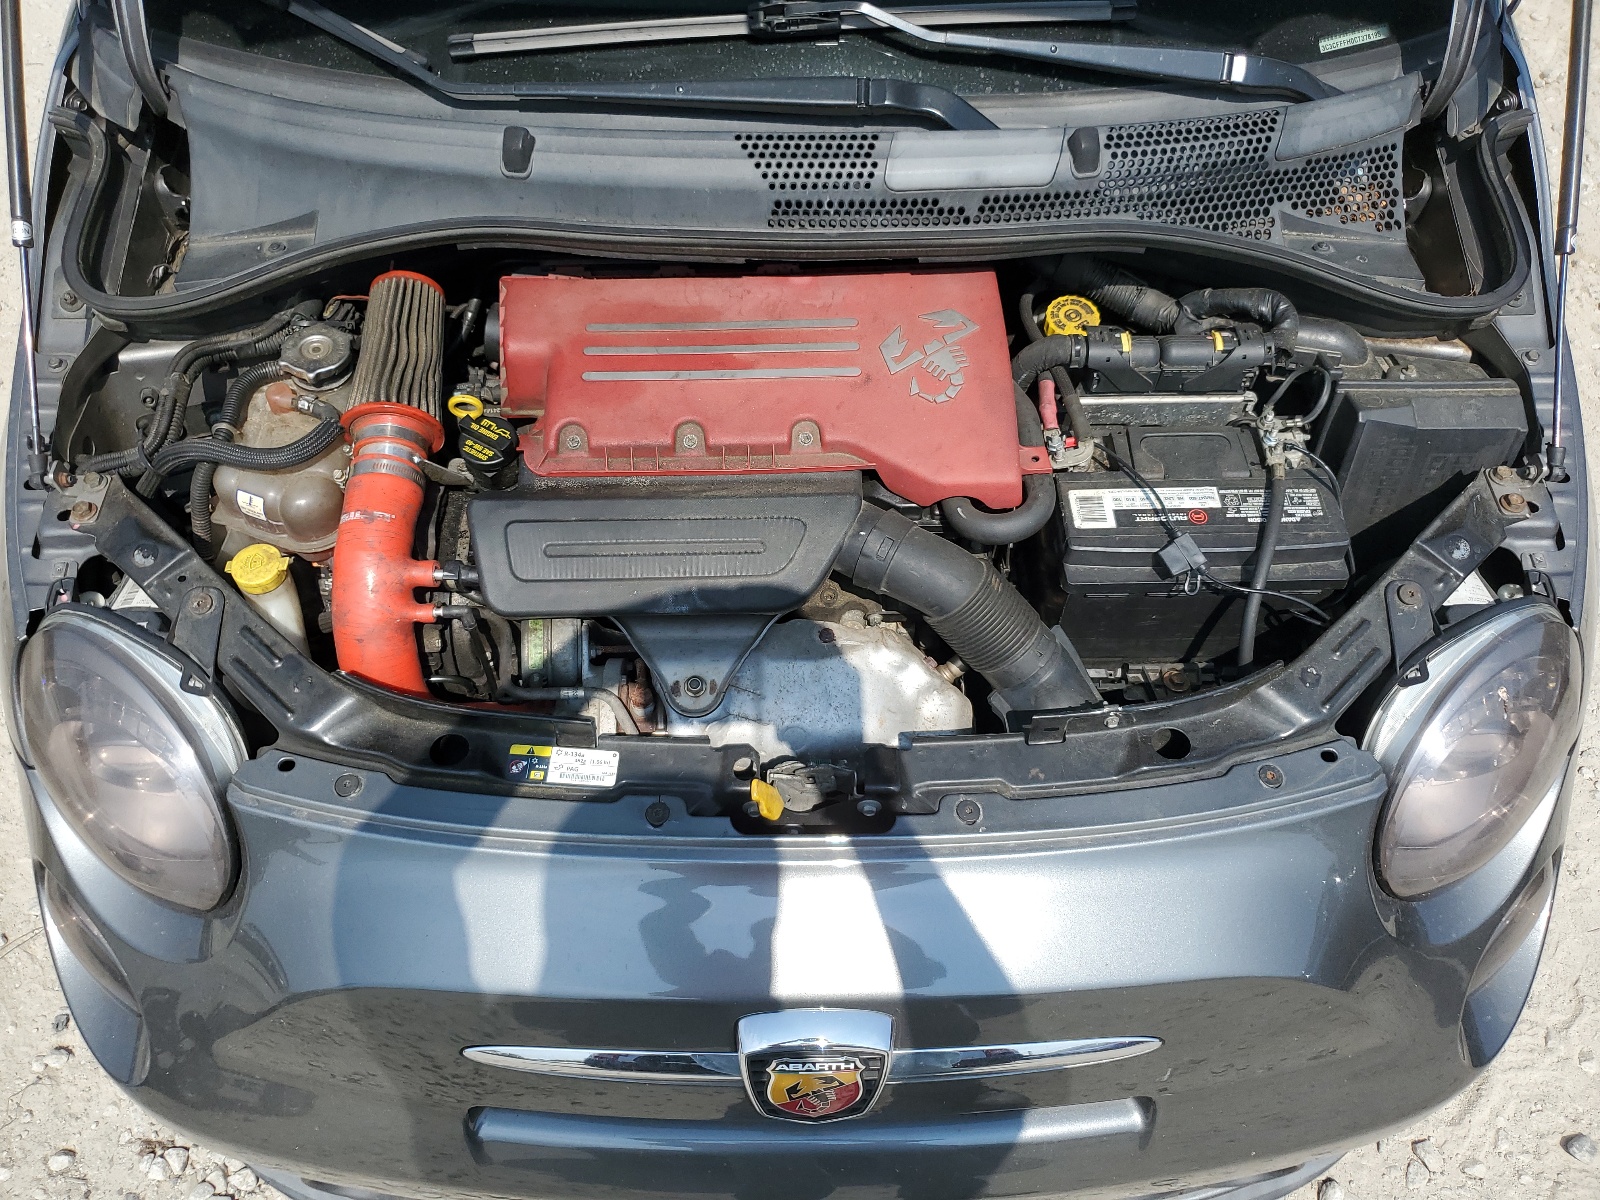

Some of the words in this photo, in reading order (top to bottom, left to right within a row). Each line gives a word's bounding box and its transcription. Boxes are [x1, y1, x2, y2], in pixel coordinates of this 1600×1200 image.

[470, 422, 479, 430] OIL
[478, 427, 499, 440] ENGINE
[465, 440, 483, 451] 5W-40
[463, 445, 488, 460] SYNTHETIC
[482, 448, 494, 456] SAE
[776, 1063, 854, 1071] ABARTH
